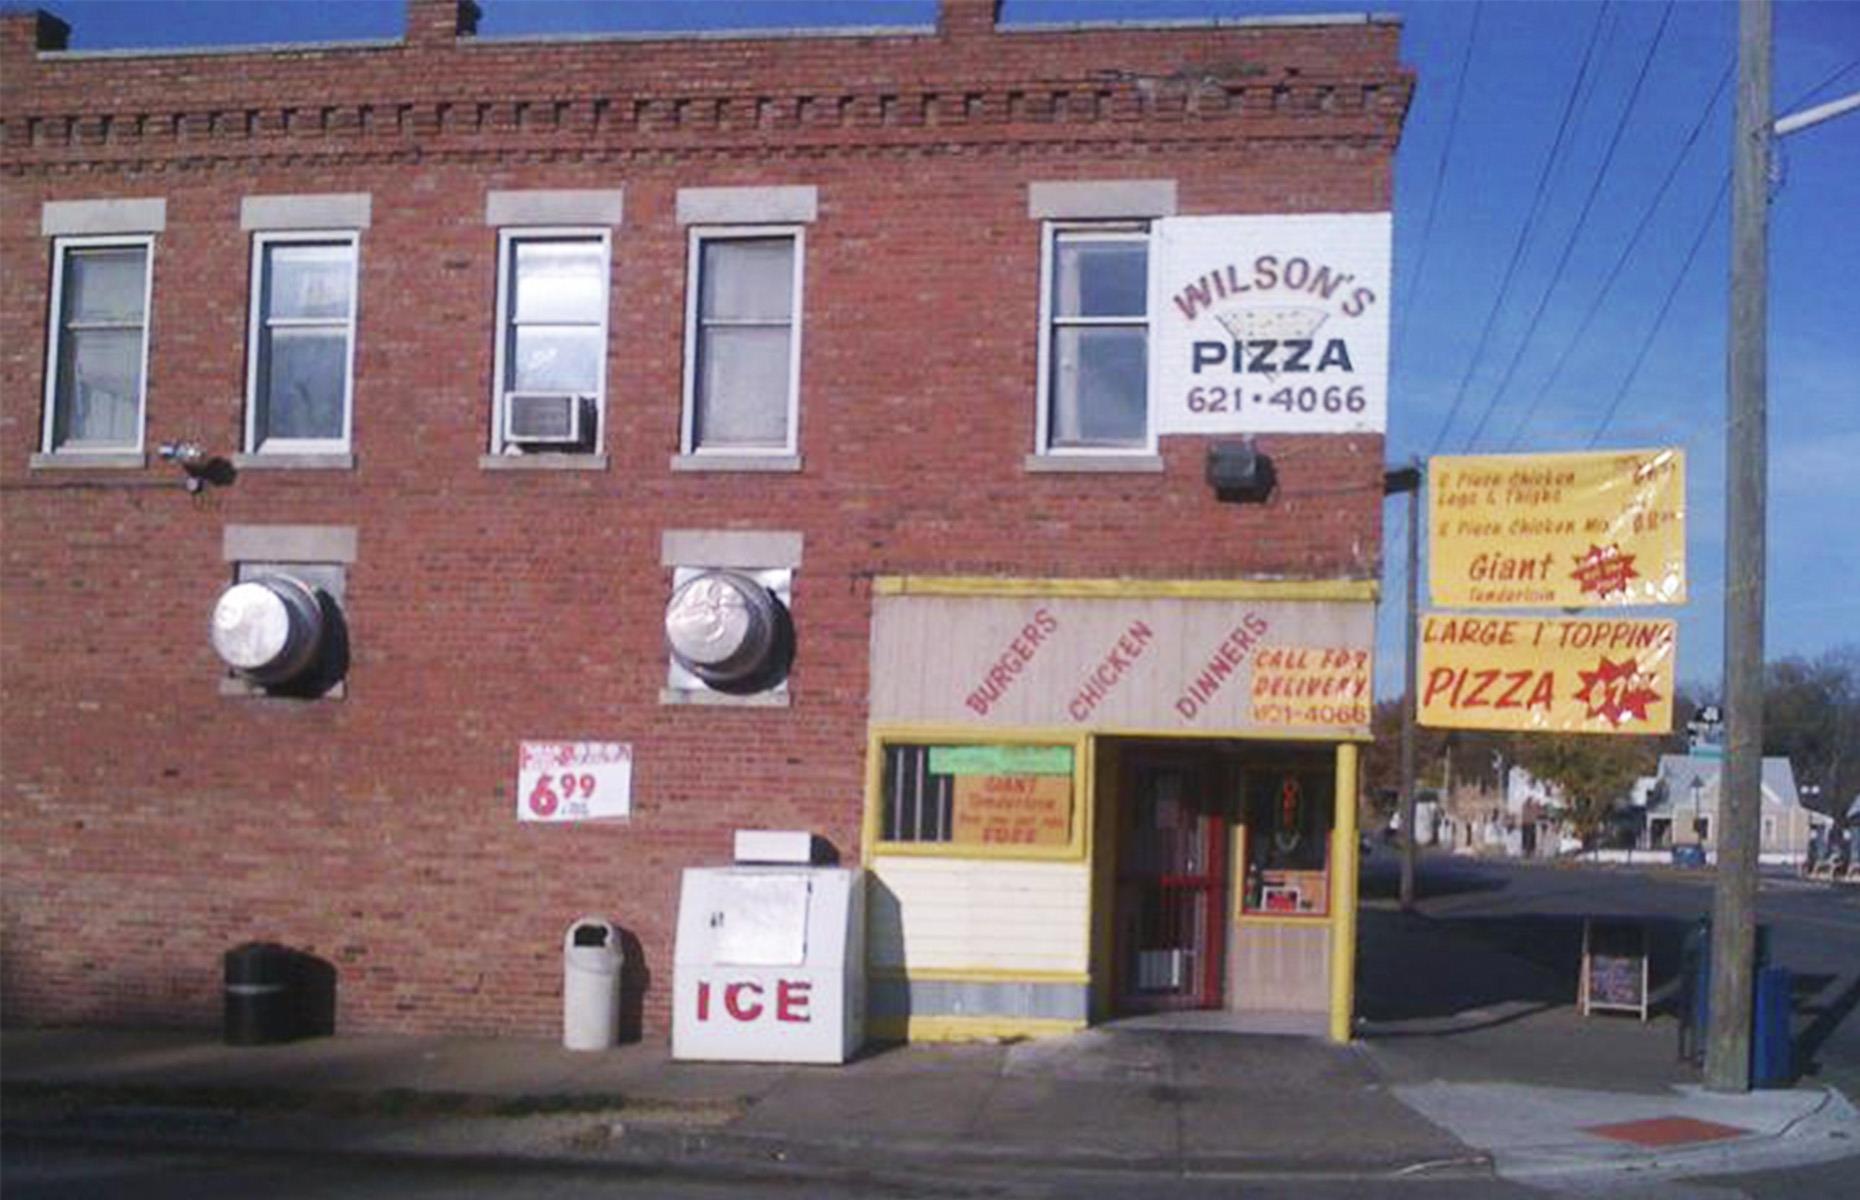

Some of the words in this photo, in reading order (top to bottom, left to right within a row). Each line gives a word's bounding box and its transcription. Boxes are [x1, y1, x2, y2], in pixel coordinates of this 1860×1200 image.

[1173, 255, 1376, 321] WILSON'S
[1192, 339, 1353, 374] PIZZA
[1468, 551, 1554, 581] Giant
[1423, 619, 1520, 647] LARGE
[965, 608, 1058, 716] BURGERS
[1068, 619, 1155, 722] CHICKEN
[1175, 611, 1269, 720] DINNERS
[1256, 648, 1307, 669] CALL
[1321, 648, 1367, 669] FOR
[1253, 676, 1368, 698] DELIVERY
[1423, 667, 1555, 711] PIZZA
[695, 979, 812, 1023] ICE
